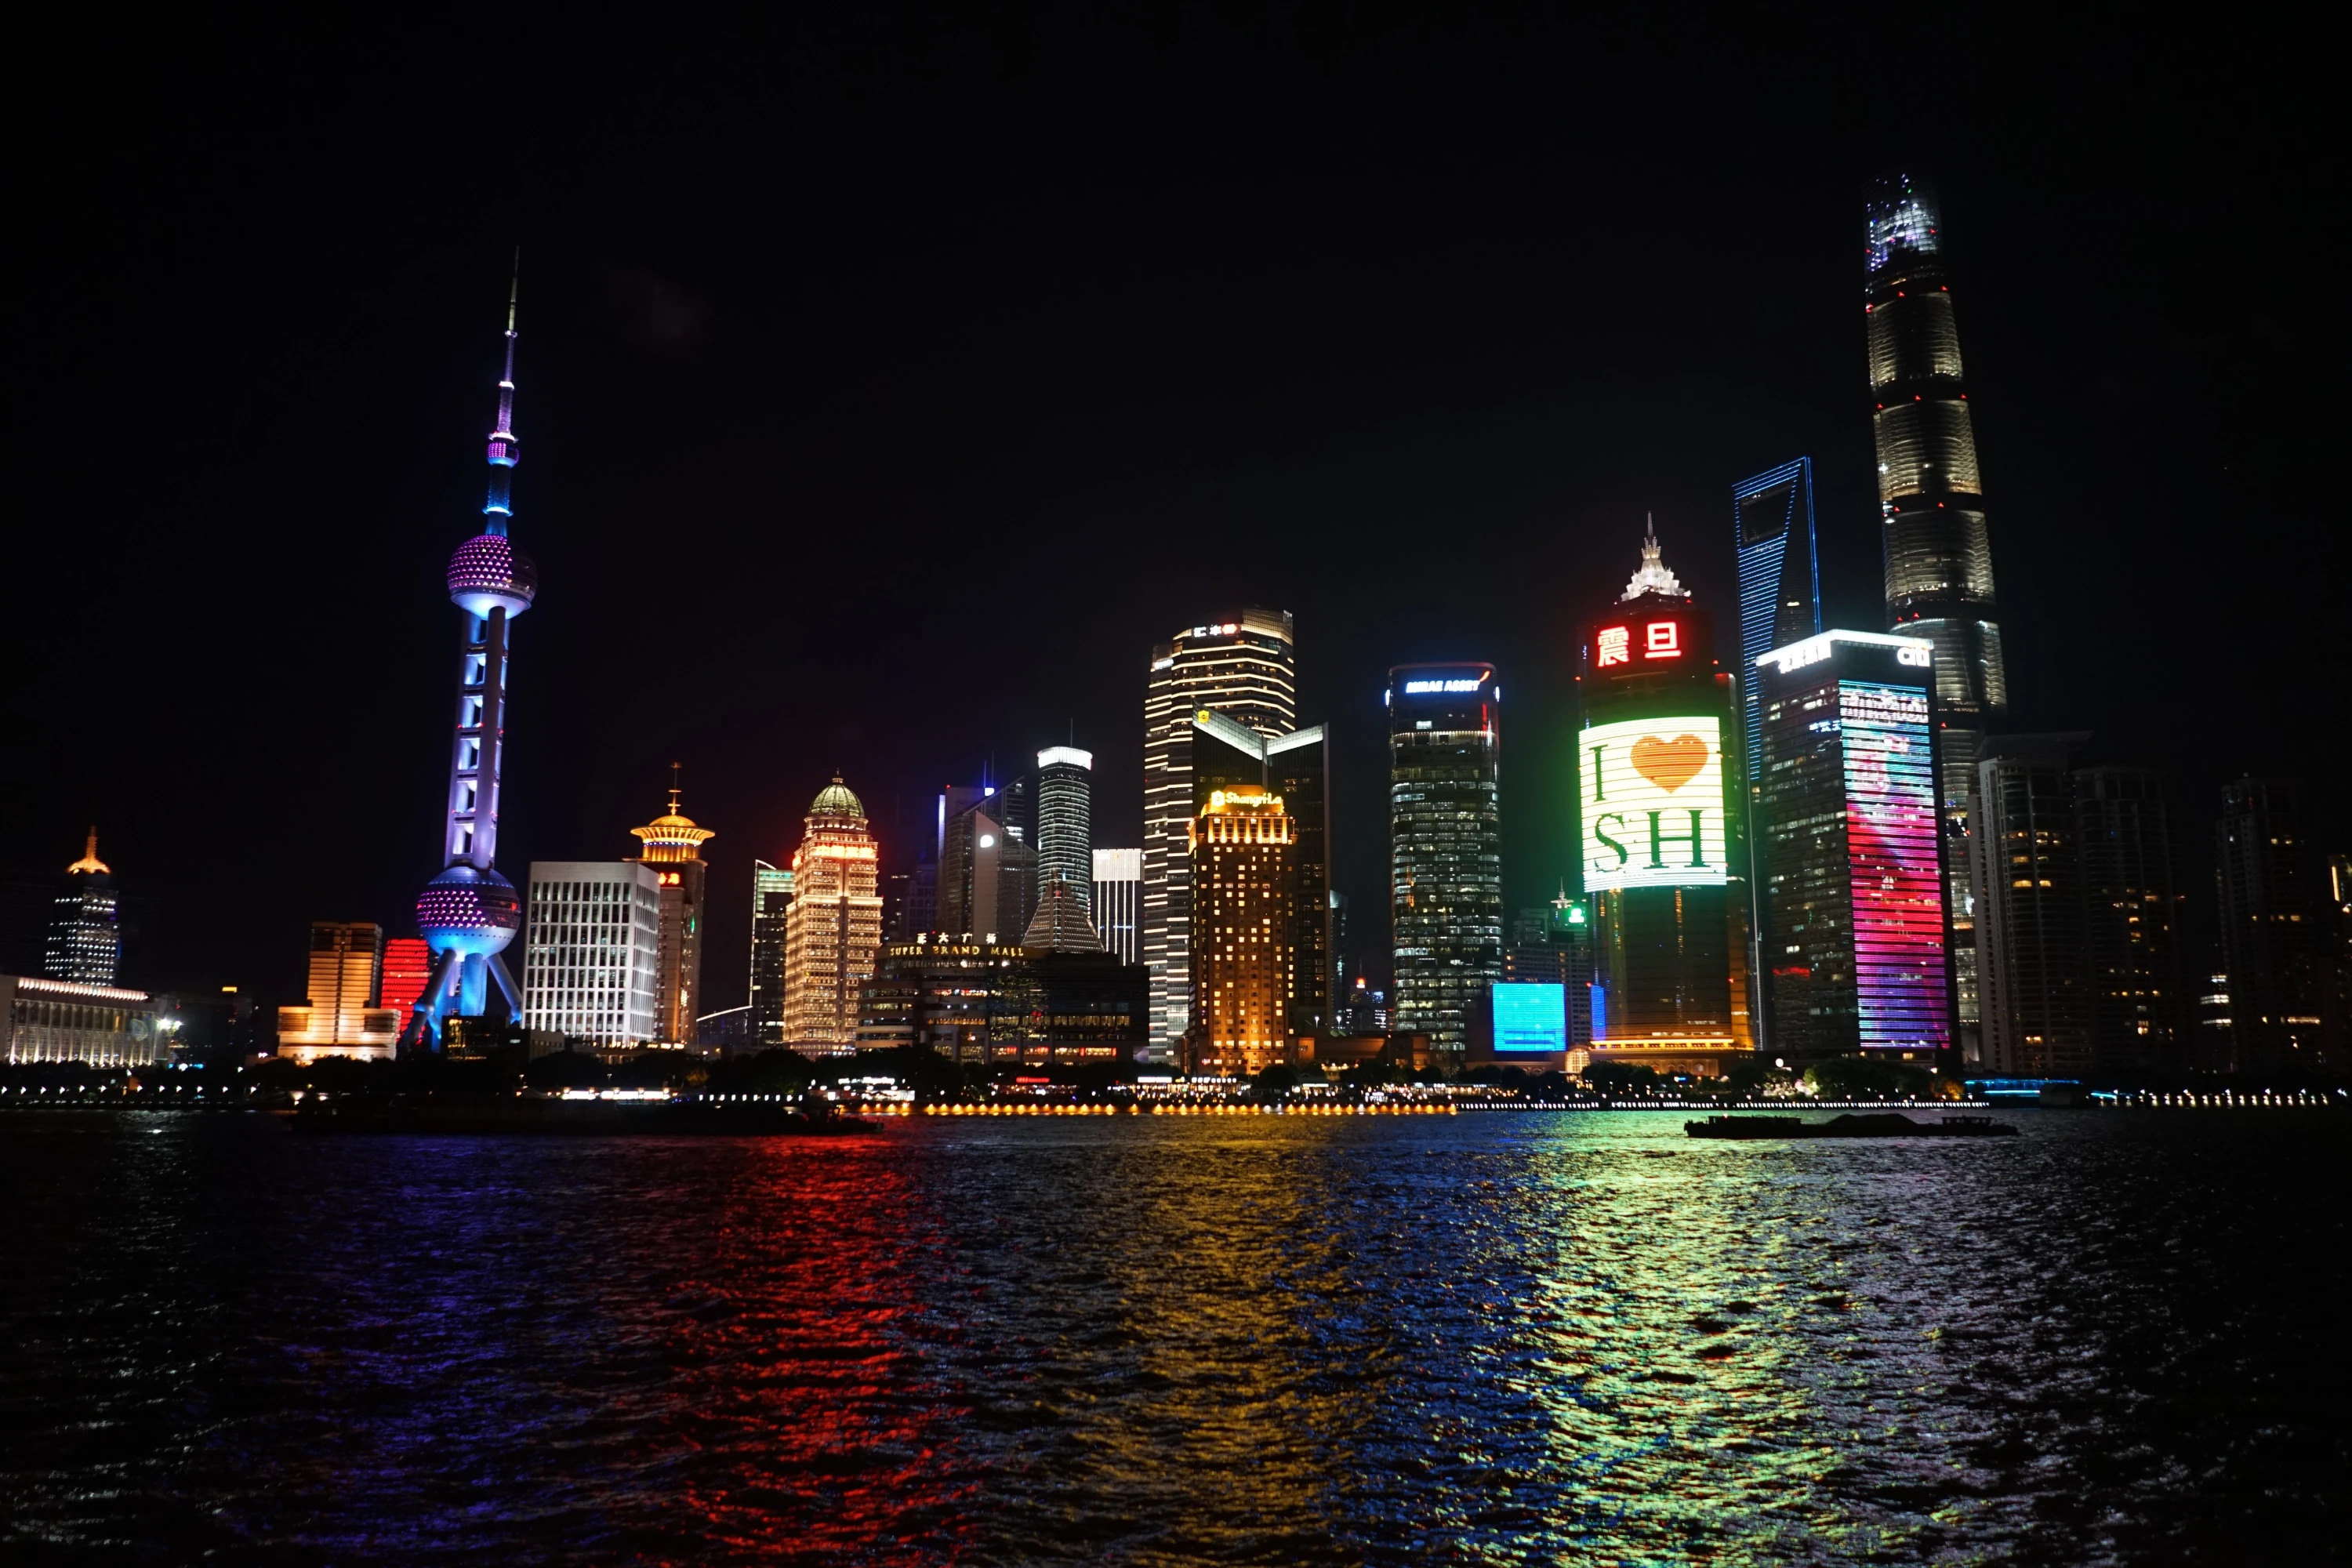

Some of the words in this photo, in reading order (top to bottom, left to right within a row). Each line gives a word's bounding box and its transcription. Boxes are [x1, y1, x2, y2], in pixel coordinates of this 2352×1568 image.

[1597, 622, 1682, 667] 震旦
[1588, 744, 1609, 802] I
[1225, 792, 1283, 808] Shangri-La
[1594, 809, 1712, 873] SH
[890, 946, 923, 956] SUPER
[932, 946, 980, 955] BRAND
[990, 946, 1024, 957] MALL
